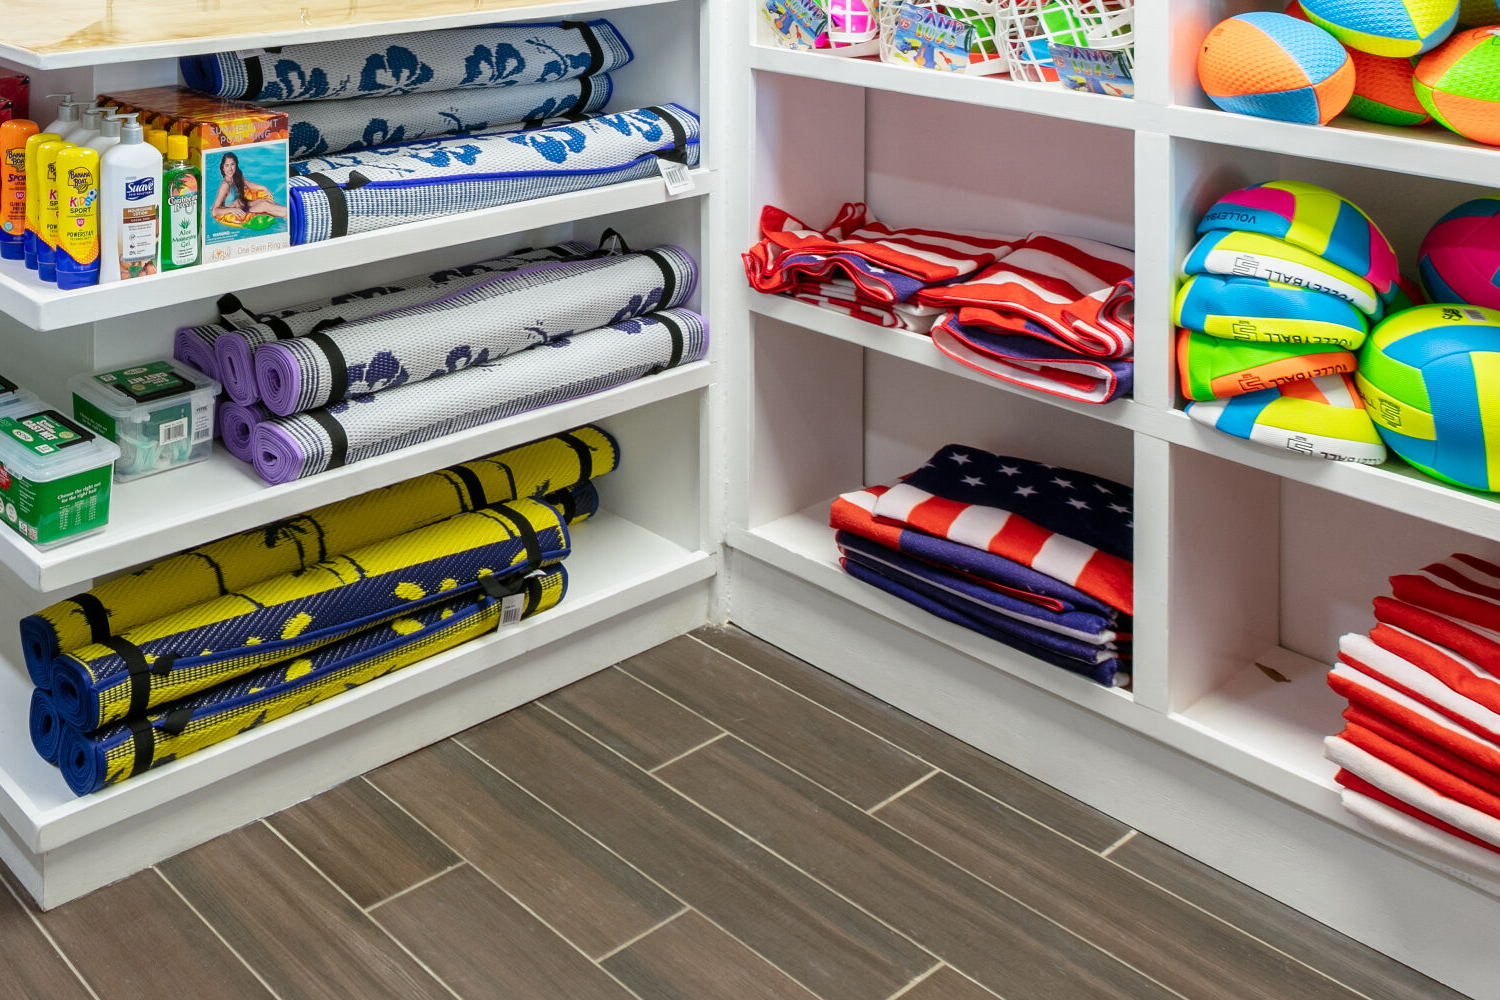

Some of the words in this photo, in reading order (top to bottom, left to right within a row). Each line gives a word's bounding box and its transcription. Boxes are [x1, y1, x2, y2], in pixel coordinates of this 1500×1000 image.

[914, 8, 965, 36] SAND
[914, 25, 958, 48] TOYS
[1062, 45, 1115, 64] SAND
[209, 121, 250, 137] SUMMER
[220, 131, 246, 145] POOL
[247, 129, 271, 140] RING
[127, 181, 154, 194] Suave
[69, 196, 92, 208] KIDS
[66, 230, 95, 238] POWERSTAY
[179, 228, 192, 236] Aloe
[181, 240, 191, 248] Gel
[238, 246, 249, 255] One
[251, 243, 266, 253] Swim
[267, 240, 281, 252] Ring
[22, 420, 46, 433] CAST
[39, 431, 59, 441] NET
[57, 491, 74, 500] Choose
[83, 484, 94, 492] right
[77, 491, 88, 499] right
